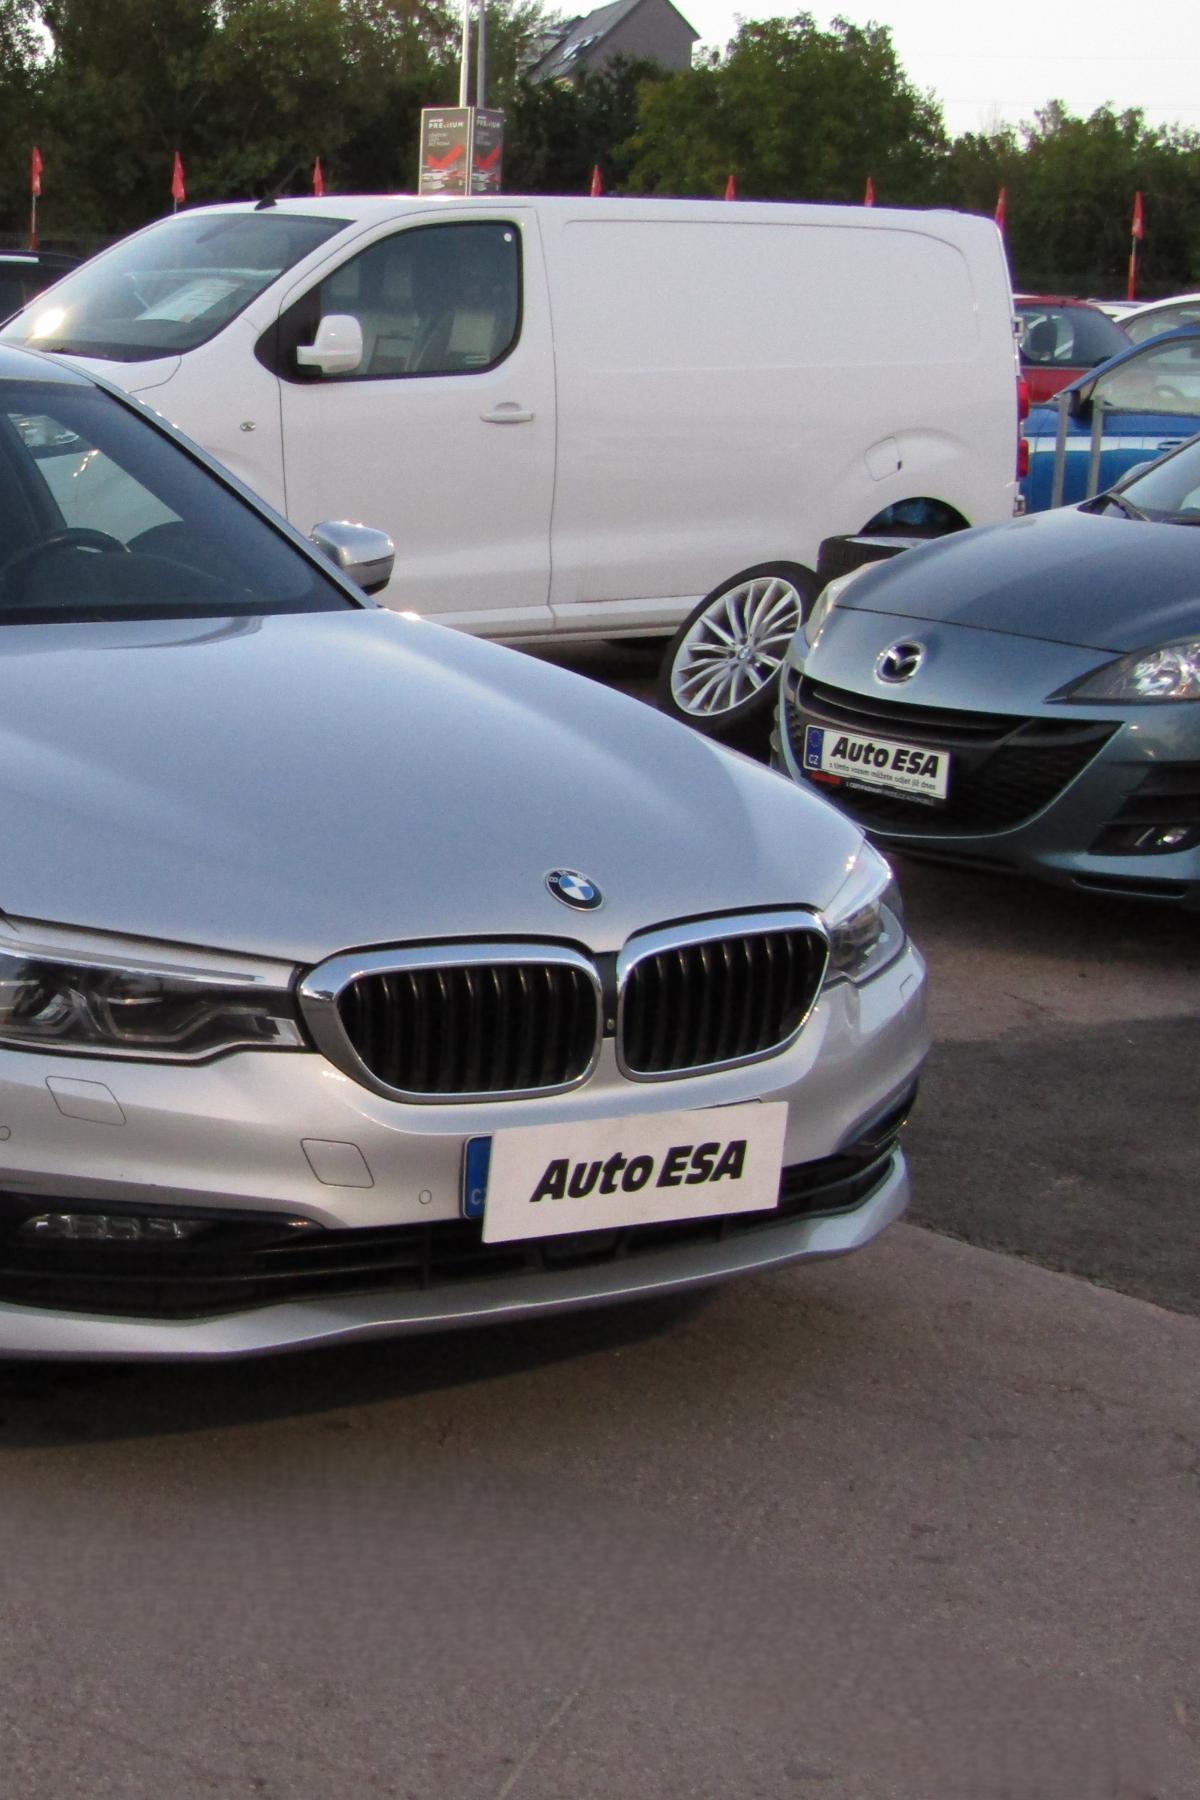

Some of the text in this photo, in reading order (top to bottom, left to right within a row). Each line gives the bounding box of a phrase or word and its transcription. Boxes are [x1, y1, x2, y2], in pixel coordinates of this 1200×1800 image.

[809, 755, 818, 765] CZ
[831, 737, 939, 778] Auto ESA
[529, 1139, 748, 1203] Auto ESA
